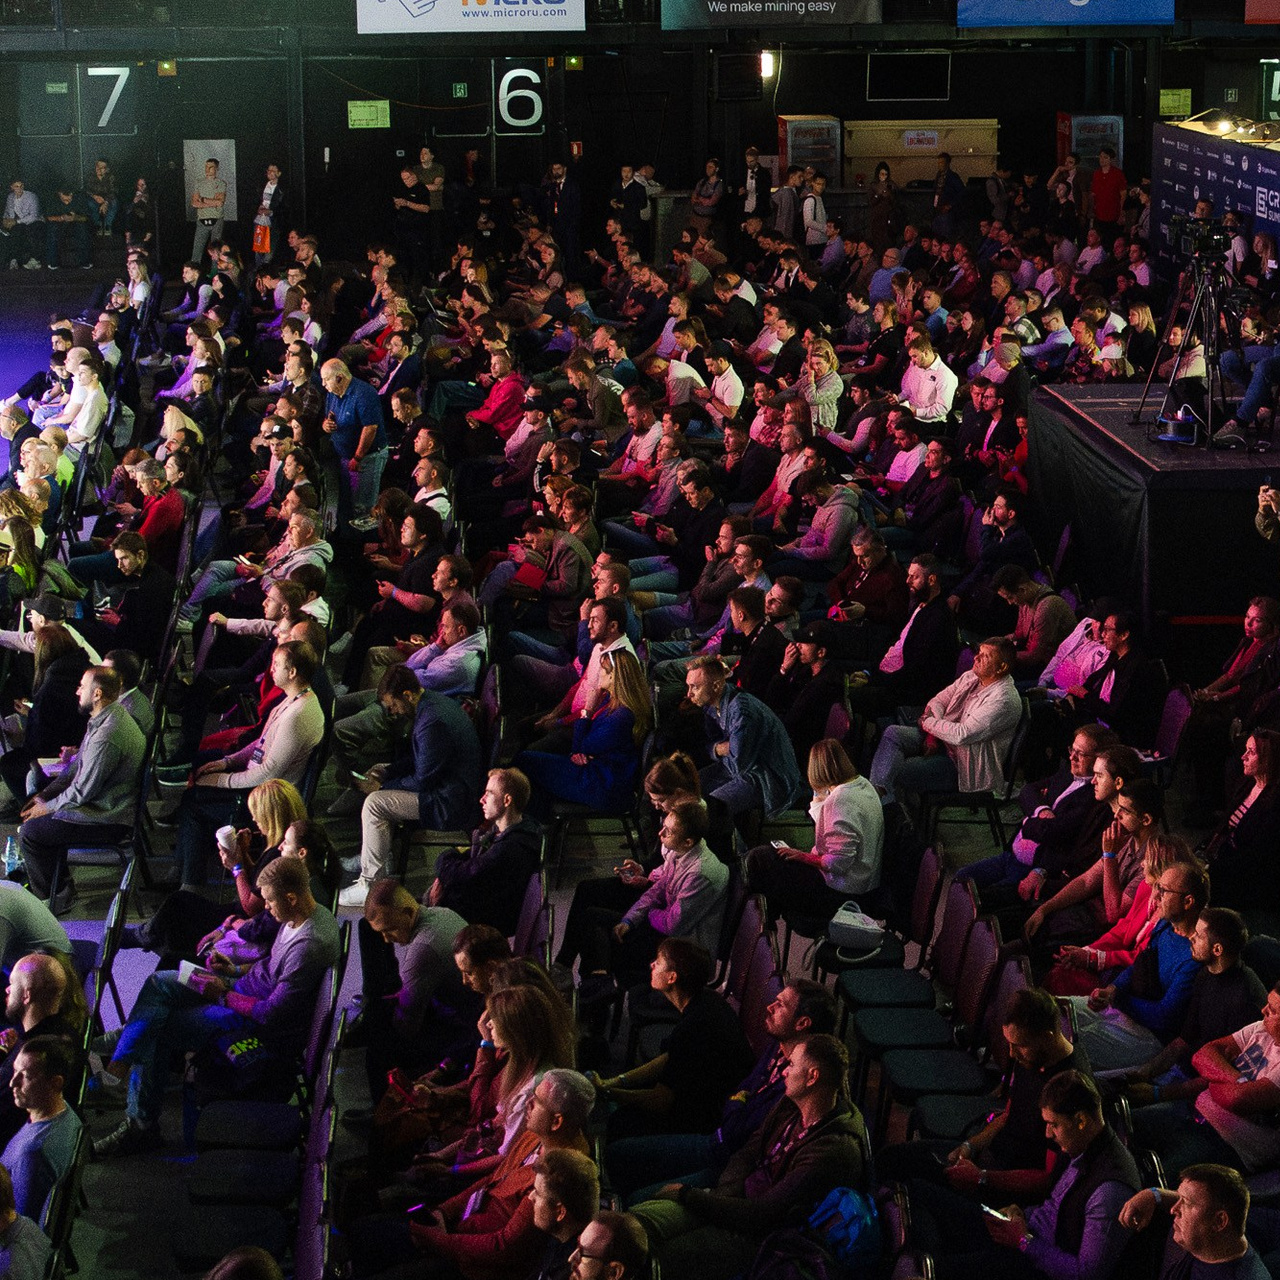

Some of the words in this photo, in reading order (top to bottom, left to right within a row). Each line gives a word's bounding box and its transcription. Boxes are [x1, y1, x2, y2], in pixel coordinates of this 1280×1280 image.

[461, 7, 568, 17] www.microru.com
[707, 1, 728, 12] We
[729, 1, 762, 12] make
[764, 1, 805, 14] mining
[808, 2, 837, 14] easy
[88, 67, 130, 127] 7
[499, 69, 543, 126] 6
